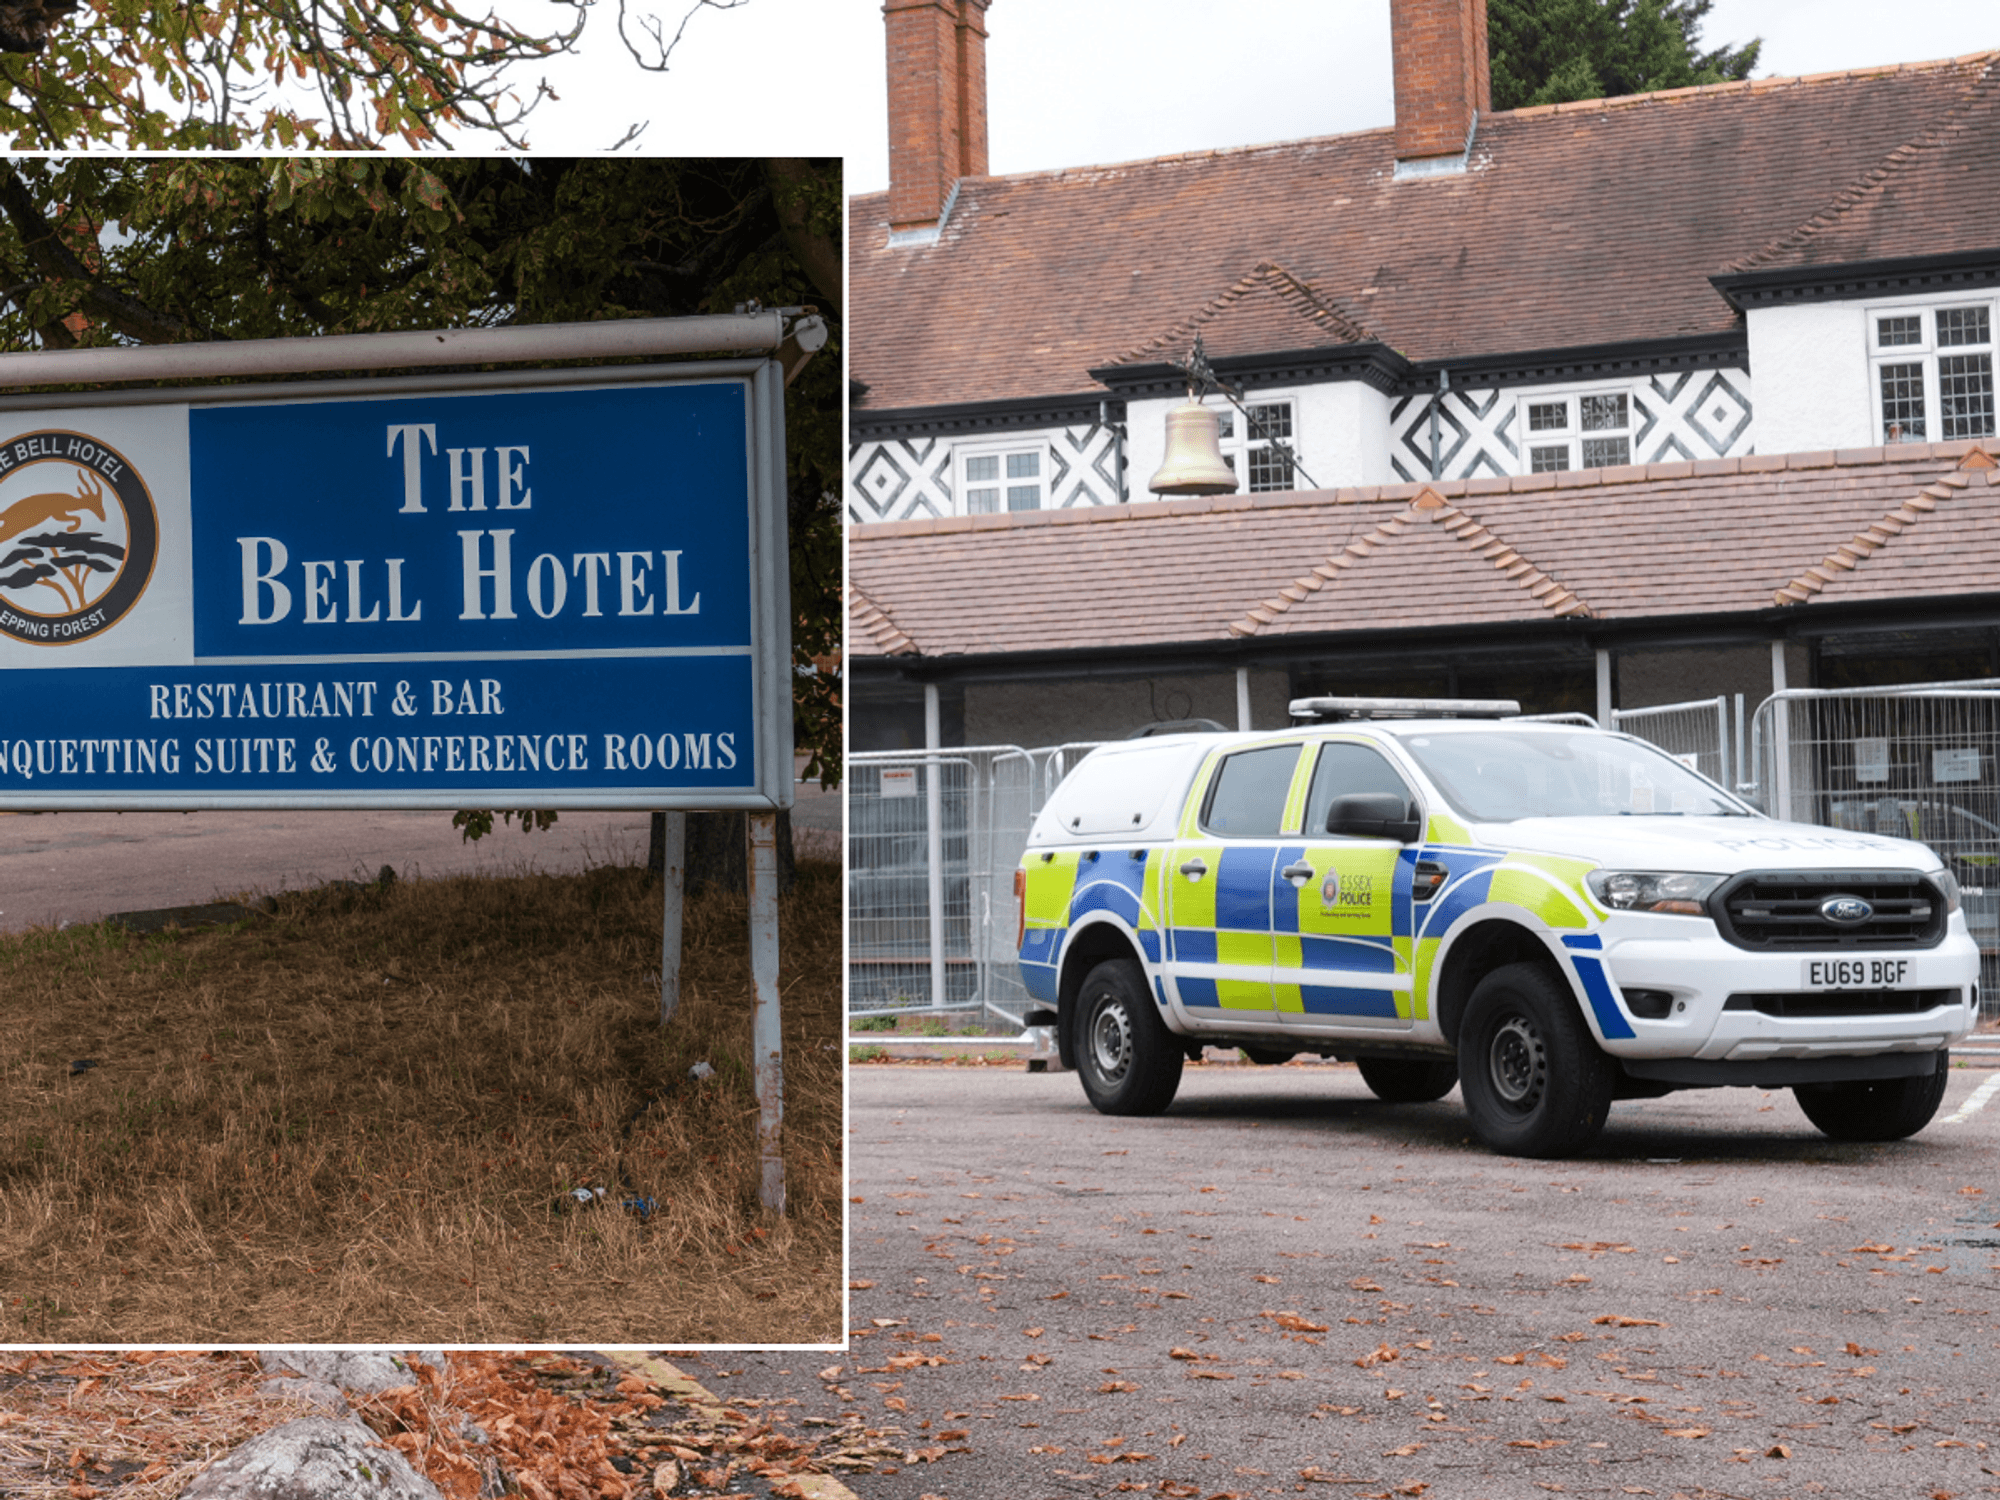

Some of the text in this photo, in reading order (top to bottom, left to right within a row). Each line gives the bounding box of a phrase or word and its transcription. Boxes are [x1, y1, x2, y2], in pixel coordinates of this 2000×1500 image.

[14, 437, 62, 461] BELL
[67, 438, 123, 482] HOTEL
[387, 424, 531, 513] THE
[237, 529, 700, 625] BELL HOTEL
[0, 608, 106, 637] EPPING FOREST
[150, 679, 505, 719] RESTAURANT & BAR
[196, 738, 296, 773] SUITE
[311, 737, 337, 773] &
[351, 734, 588, 773] CONFERENCE
[605, 733, 736, 770] ROOMS
[1714, 838, 1899, 853] POLICE
[1340, 874, 1372, 891] ESSEX
[1958, 885, 1983, 897] king
[1340, 891, 1371, 906] POLICE
[1836, 901, 1862, 917] Ford
[1811, 960, 1908, 986] EU69 BGF
